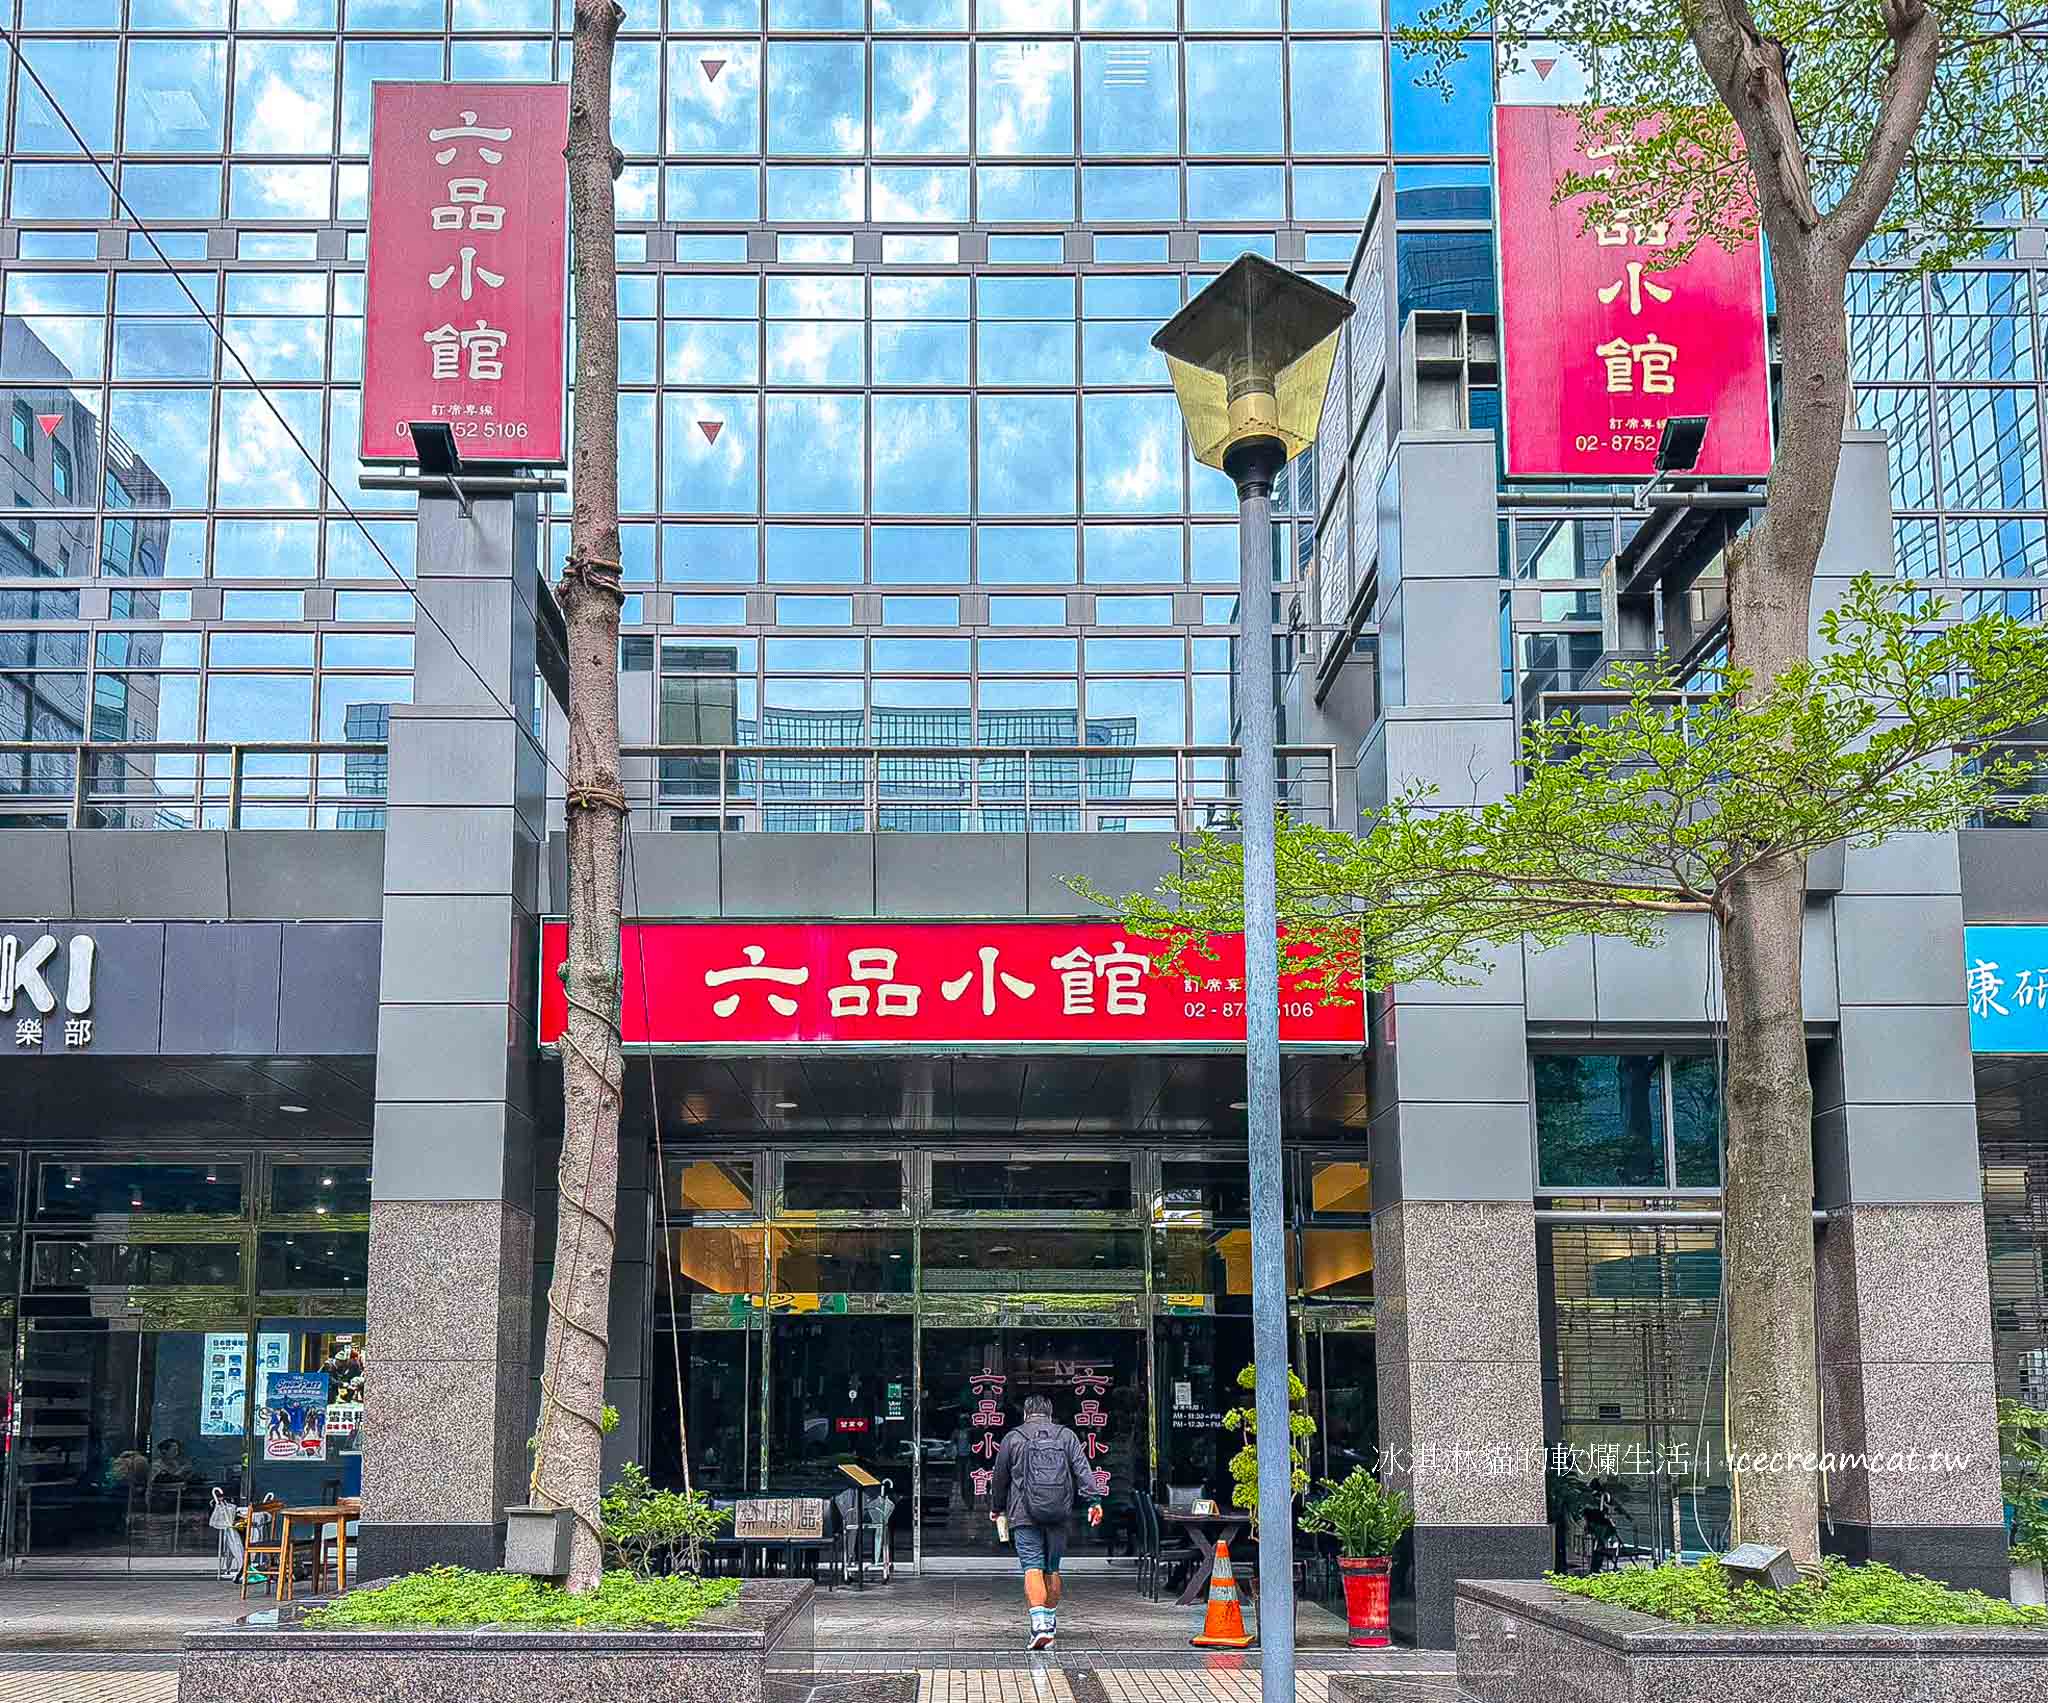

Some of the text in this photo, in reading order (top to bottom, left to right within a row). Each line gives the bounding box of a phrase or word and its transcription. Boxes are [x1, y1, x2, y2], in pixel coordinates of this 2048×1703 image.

[423, 110, 513, 381] 六品小館
[483, 422, 528, 438] 5106
[705, 941, 1151, 1018] 六品小館
[1277, 1002, 1314, 1018] 106
[15, 1018, 92, 1046] 樂部
